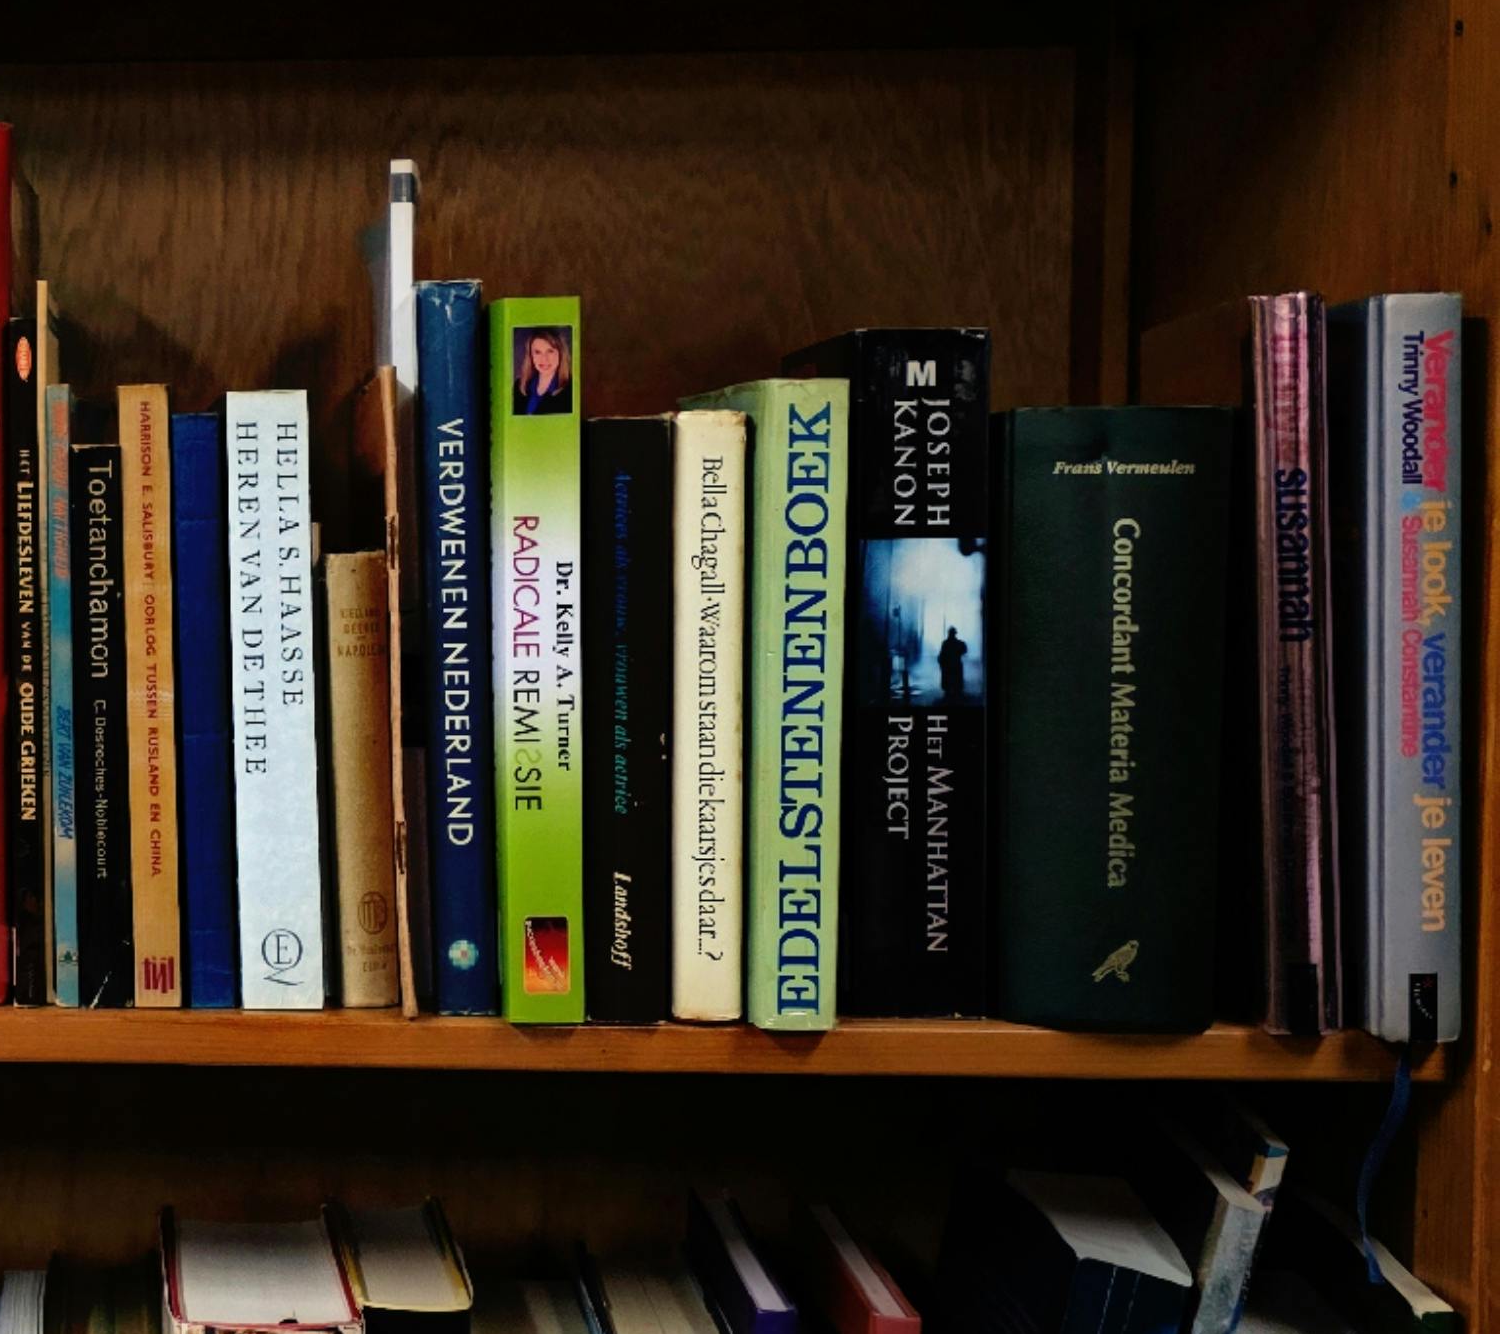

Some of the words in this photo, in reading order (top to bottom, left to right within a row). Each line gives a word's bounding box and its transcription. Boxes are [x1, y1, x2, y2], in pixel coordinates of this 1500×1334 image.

[1398, 330, 1424, 396] Trinny
[235, 422, 262, 541] HEREN
[275, 422, 301, 535] HELLA
[893, 398, 918, 526] KANON
[922, 397, 951, 527] JOSEPH
[1402, 399, 1423, 485] Woodall
[87, 459, 116, 678] Toetanchamon
[277, 545, 301, 569] S.
[435, 418, 469, 630] VERDWENEN
[145, 593, 157, 656] OORLOG
[238, 548, 263, 615] VAN
[512, 516, 541, 659] RADICALE
[555, 561, 577, 596] Dr.
[1109, 517, 1141, 674] Concordant
[240, 628, 264, 671] DE
[278, 574, 305, 707] HAASSE
[554, 603, 574, 658] Kelly
[555, 665, 574, 689] A.
[147, 663, 159, 718] TUSSEN
[242, 679, 268, 775] THEE
[556, 694, 576, 771] Turner
[777, 401, 833, 1015] EDELSTENENBOEK
[1108, 680, 1137, 783] Materia
[149, 726, 162, 796] RUSLAND
[441, 642, 475, 846] NEDERLAND
[882, 715, 914, 840] PROJECT
[150, 802, 162, 823] EN
[150, 828, 164, 877] CHINA
[925, 764, 955, 953] MANHATTAN
[1106, 791, 1137, 888] Medica
